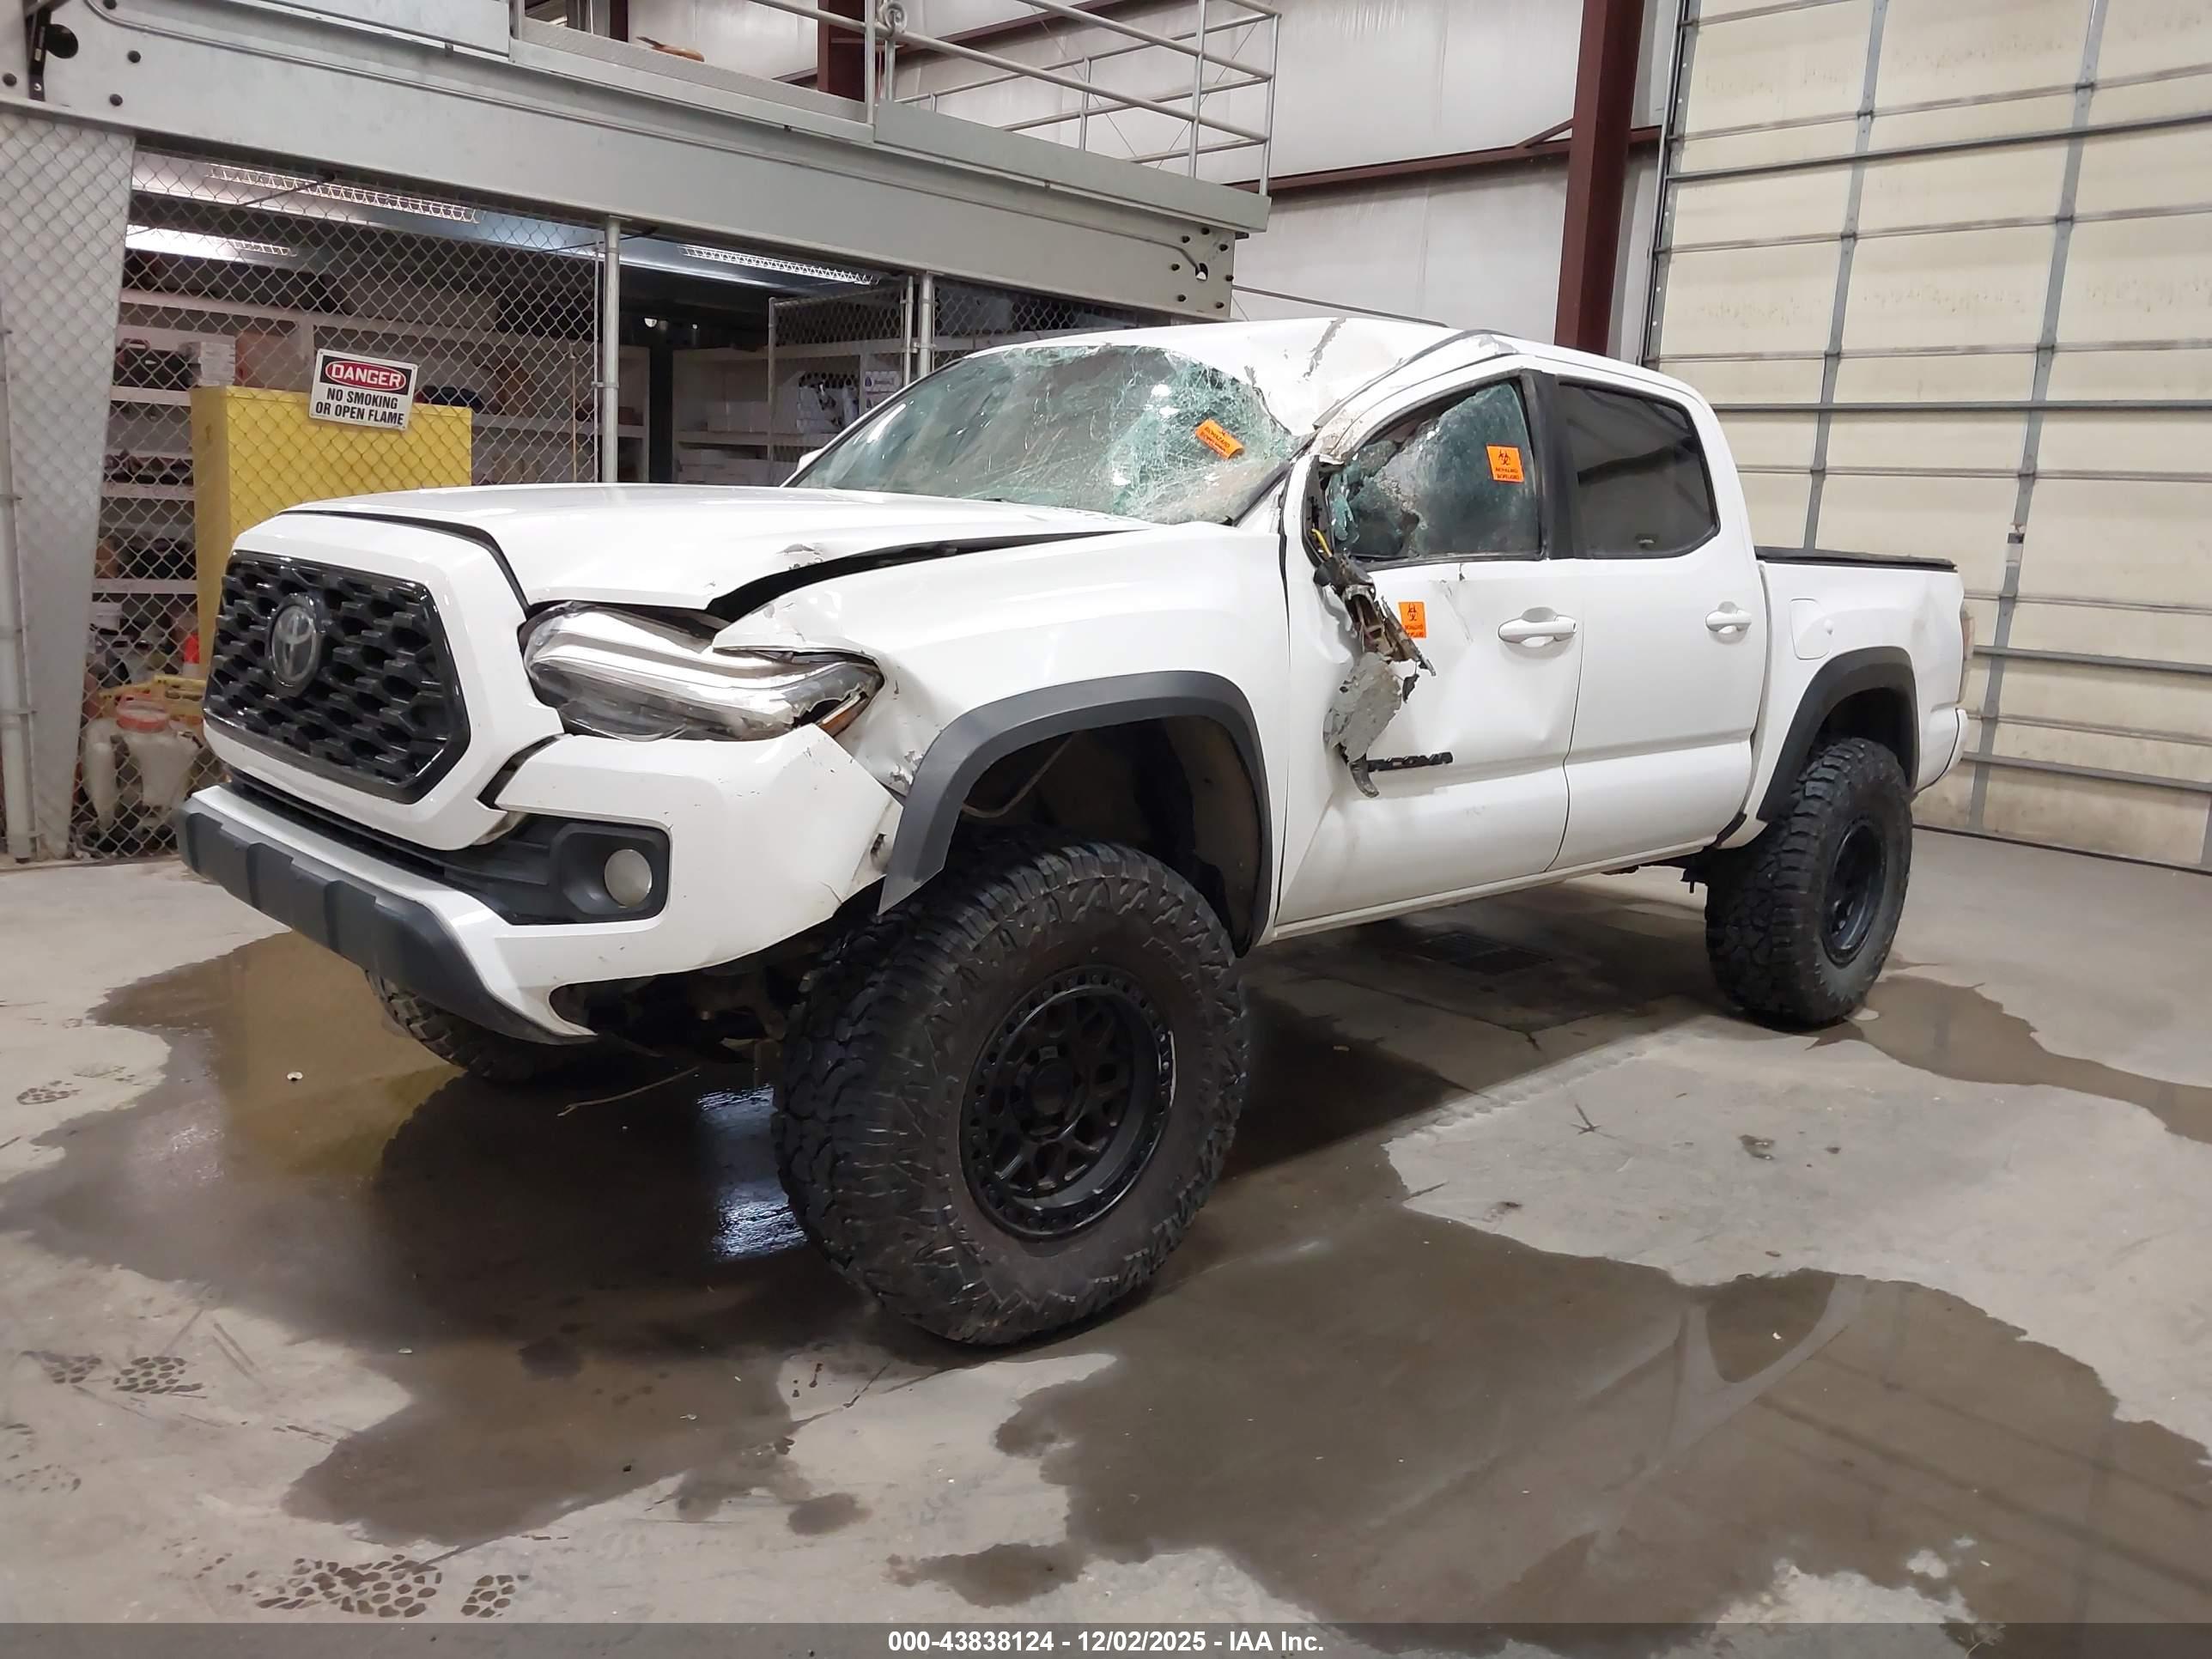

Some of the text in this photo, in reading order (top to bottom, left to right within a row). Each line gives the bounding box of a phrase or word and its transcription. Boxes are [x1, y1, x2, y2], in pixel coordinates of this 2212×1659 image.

[331, 364, 402, 387] DANGER
[326, 387, 398, 410] NO SMOKING
[315, 401, 404, 426] OR OPEN FLAME
[1367, 751, 1454, 773] ACOMA
